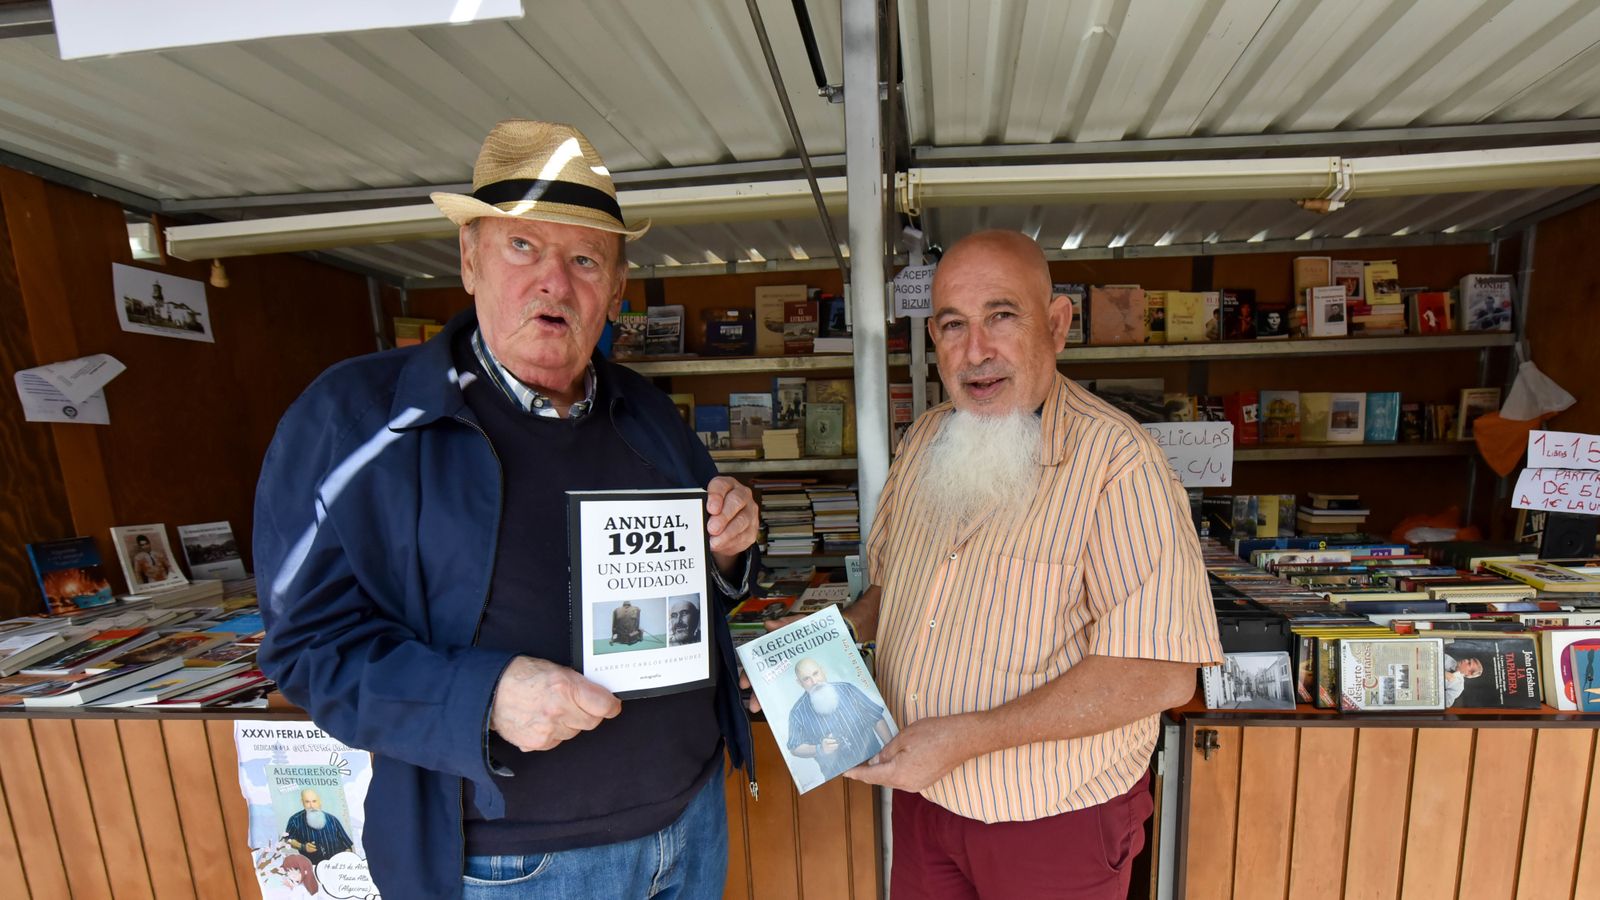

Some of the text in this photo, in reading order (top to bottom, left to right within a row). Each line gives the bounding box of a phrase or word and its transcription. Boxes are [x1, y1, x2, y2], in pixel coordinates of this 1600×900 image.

[903, 270, 936, 280] ACEPT
[895, 284, 922, 294] AGOS
[1531, 468, 1543, 481] A
[1543, 481, 1569, 495] DE
[1520, 494, 1532, 506] A
[1567, 500, 1585, 510] LA
[604, 515, 689, 531] ANNUAL,
[608, 531, 686, 556] 1921.
[598, 558, 695, 576] UN DESASTRE
[607, 574, 689, 591] OLVIDADO.
[751, 614, 836, 661] ALGECIREÑOS
[756, 628, 840, 673] DISTINGUIDOS
[1505, 652, 1517, 695] TAPADERA
[1517, 668, 1526, 679] LA
[1522, 649, 1536, 698] John Grisham
[1352, 665, 1362, 703] desierto
[241, 728, 275, 739] XXXVI
[277, 729, 305, 739] FERIA
[306, 729, 326, 739] DEL
[273, 766, 338, 777] ALGECIREÑOS
[275, 777, 339, 787] DISTINGUIDOS
